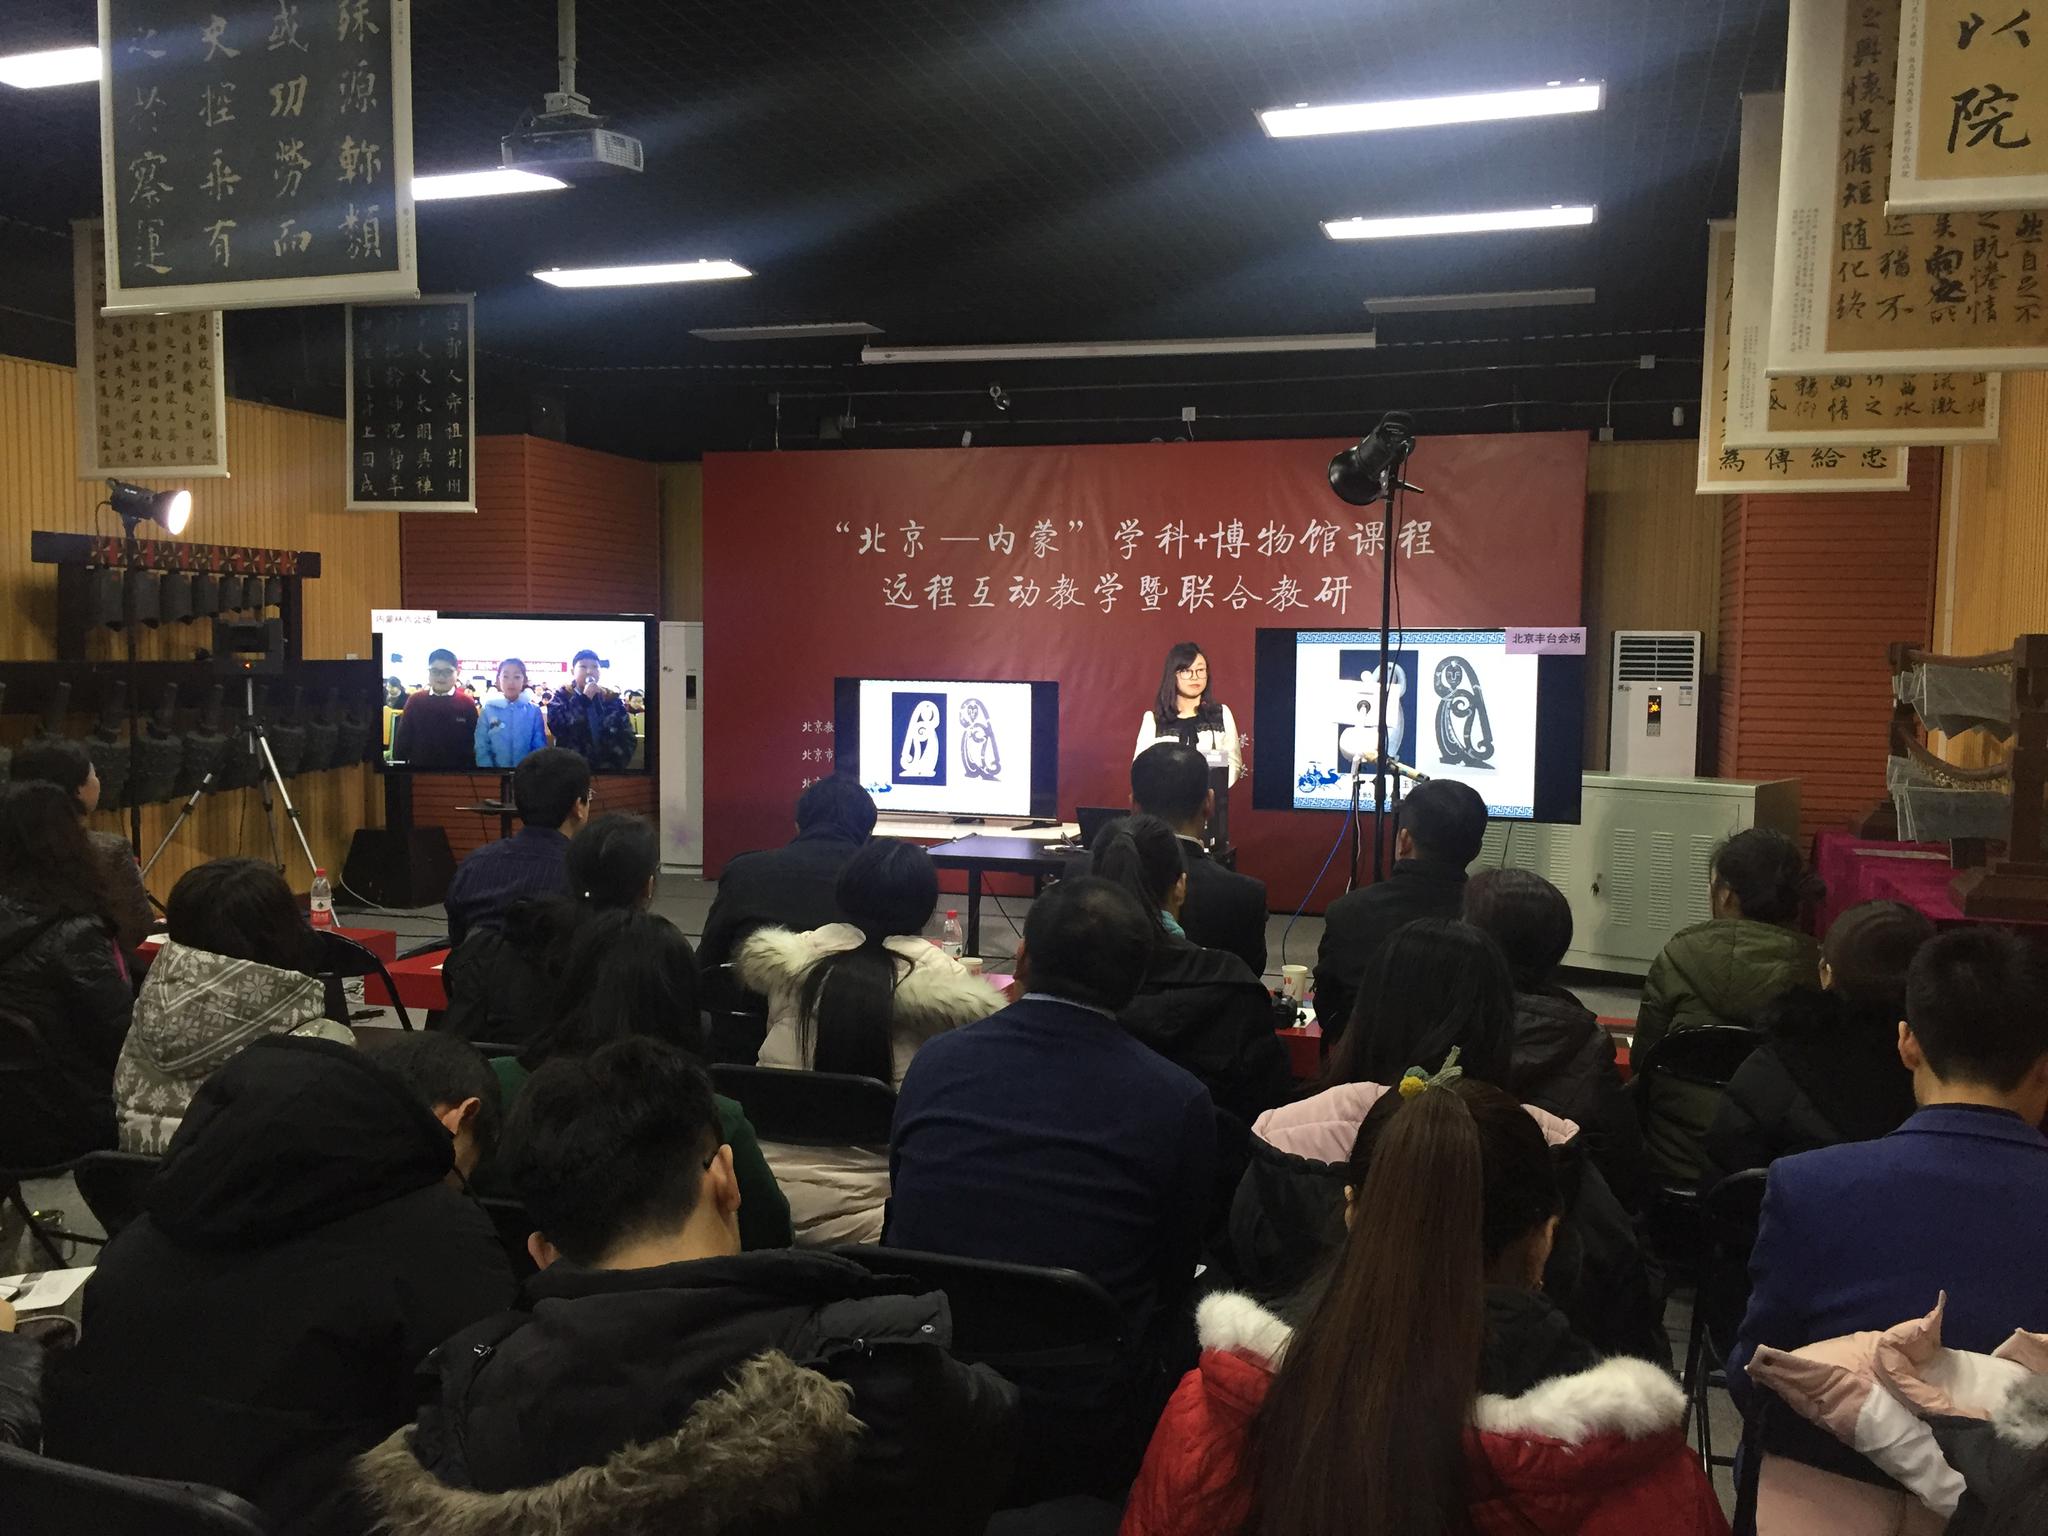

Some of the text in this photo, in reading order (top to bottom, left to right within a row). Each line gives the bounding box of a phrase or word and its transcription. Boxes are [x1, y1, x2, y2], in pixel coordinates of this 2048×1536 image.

[1113, 518, 1435, 561] 学科+博物馆课程
[882, 572, 1352, 615] 远程互动教学暨联合教研
[1512, 632, 1581, 645] 北京丰台会场
